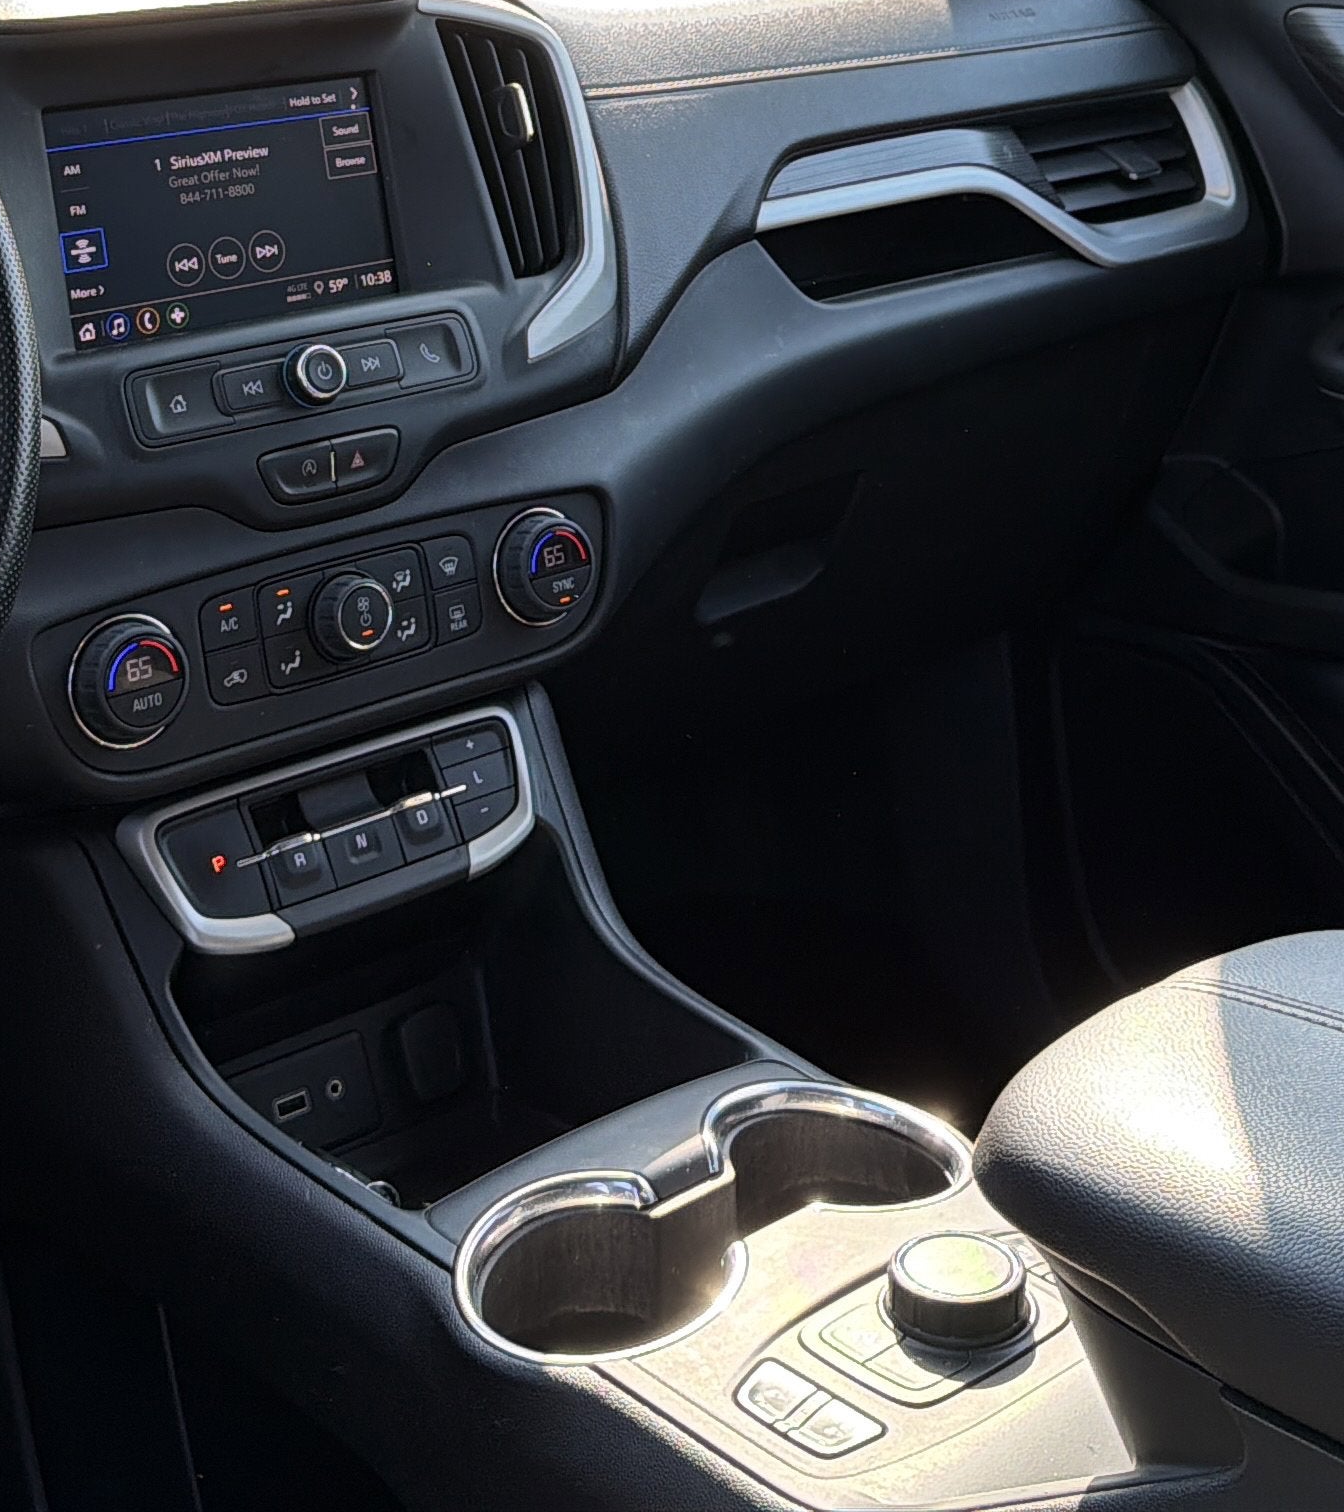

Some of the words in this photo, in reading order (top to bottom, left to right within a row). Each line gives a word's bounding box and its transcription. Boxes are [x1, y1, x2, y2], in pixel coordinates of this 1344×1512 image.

[289, 94, 311, 108] Hold
[311, 95, 322, 105] to
[322, 93, 337, 104] Set
[332, 123, 360, 137] Sound
[154, 158, 162, 172] 1
[169, 150, 223, 170] SiriusXM
[223, 145, 269, 163] Preview
[335, 156, 367, 168] Browse
[63, 164, 81, 177] AM
[168, 173, 199, 188] Great
[200, 169, 230, 185] Offer
[232, 164, 261, 179] Now!
[179, 183, 256, 205] 844-711-8800
[69, 204, 86, 217] FM
[215, 253, 238, 265] Tune
[360, 270, 393, 288] 10:38
[70, 287, 97, 300] More
[543, 544, 566, 569] 65
[552, 576, 576, 595] SYNC
[220, 616, 239, 633] A/C
[450, 618, 469, 632] REAR
[125, 655, 153, 683] 65
[132, 691, 164, 713] AUTO
[355, 833, 368, 849] N
[211, 855, 227, 873] P
[293, 851, 308, 867] R
